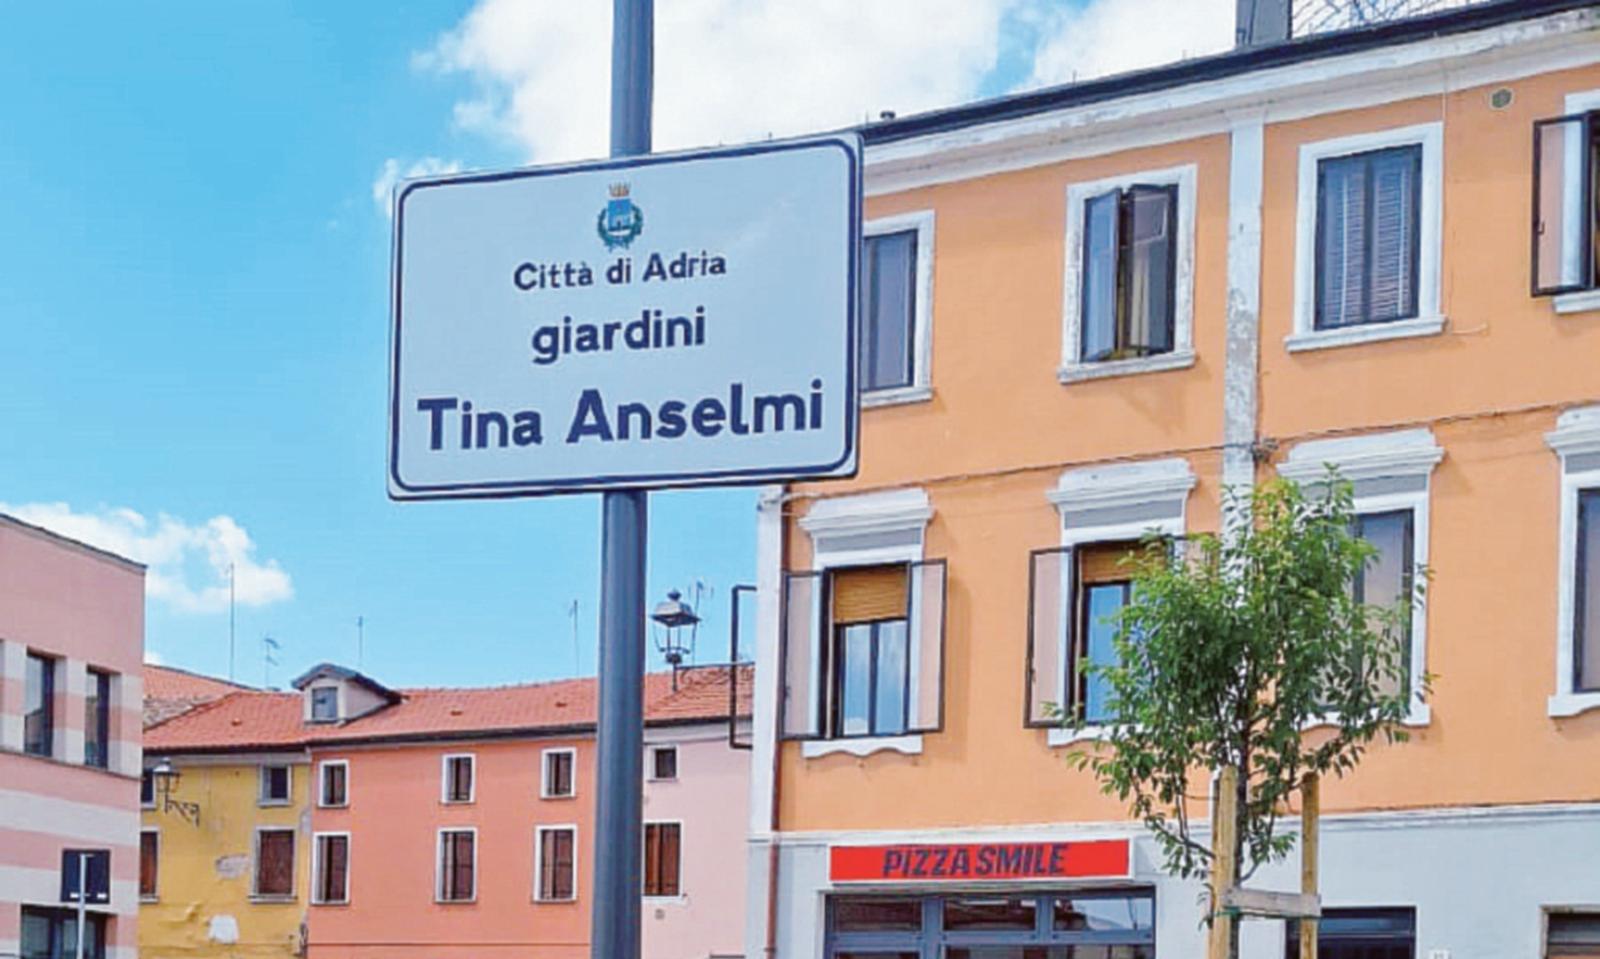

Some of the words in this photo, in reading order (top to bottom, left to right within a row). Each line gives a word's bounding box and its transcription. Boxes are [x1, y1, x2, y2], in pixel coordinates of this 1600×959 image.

[514, 260, 593, 290] Città
[606, 256, 632, 285] di
[642, 250, 727, 282] Adria
[532, 306, 706, 366] giardini
[417, 397, 543, 451] Tina
[566, 379, 823, 444] Anselmi
[882, 847, 970, 878] PIZZA
[975, 843, 1067, 875] SMILE
